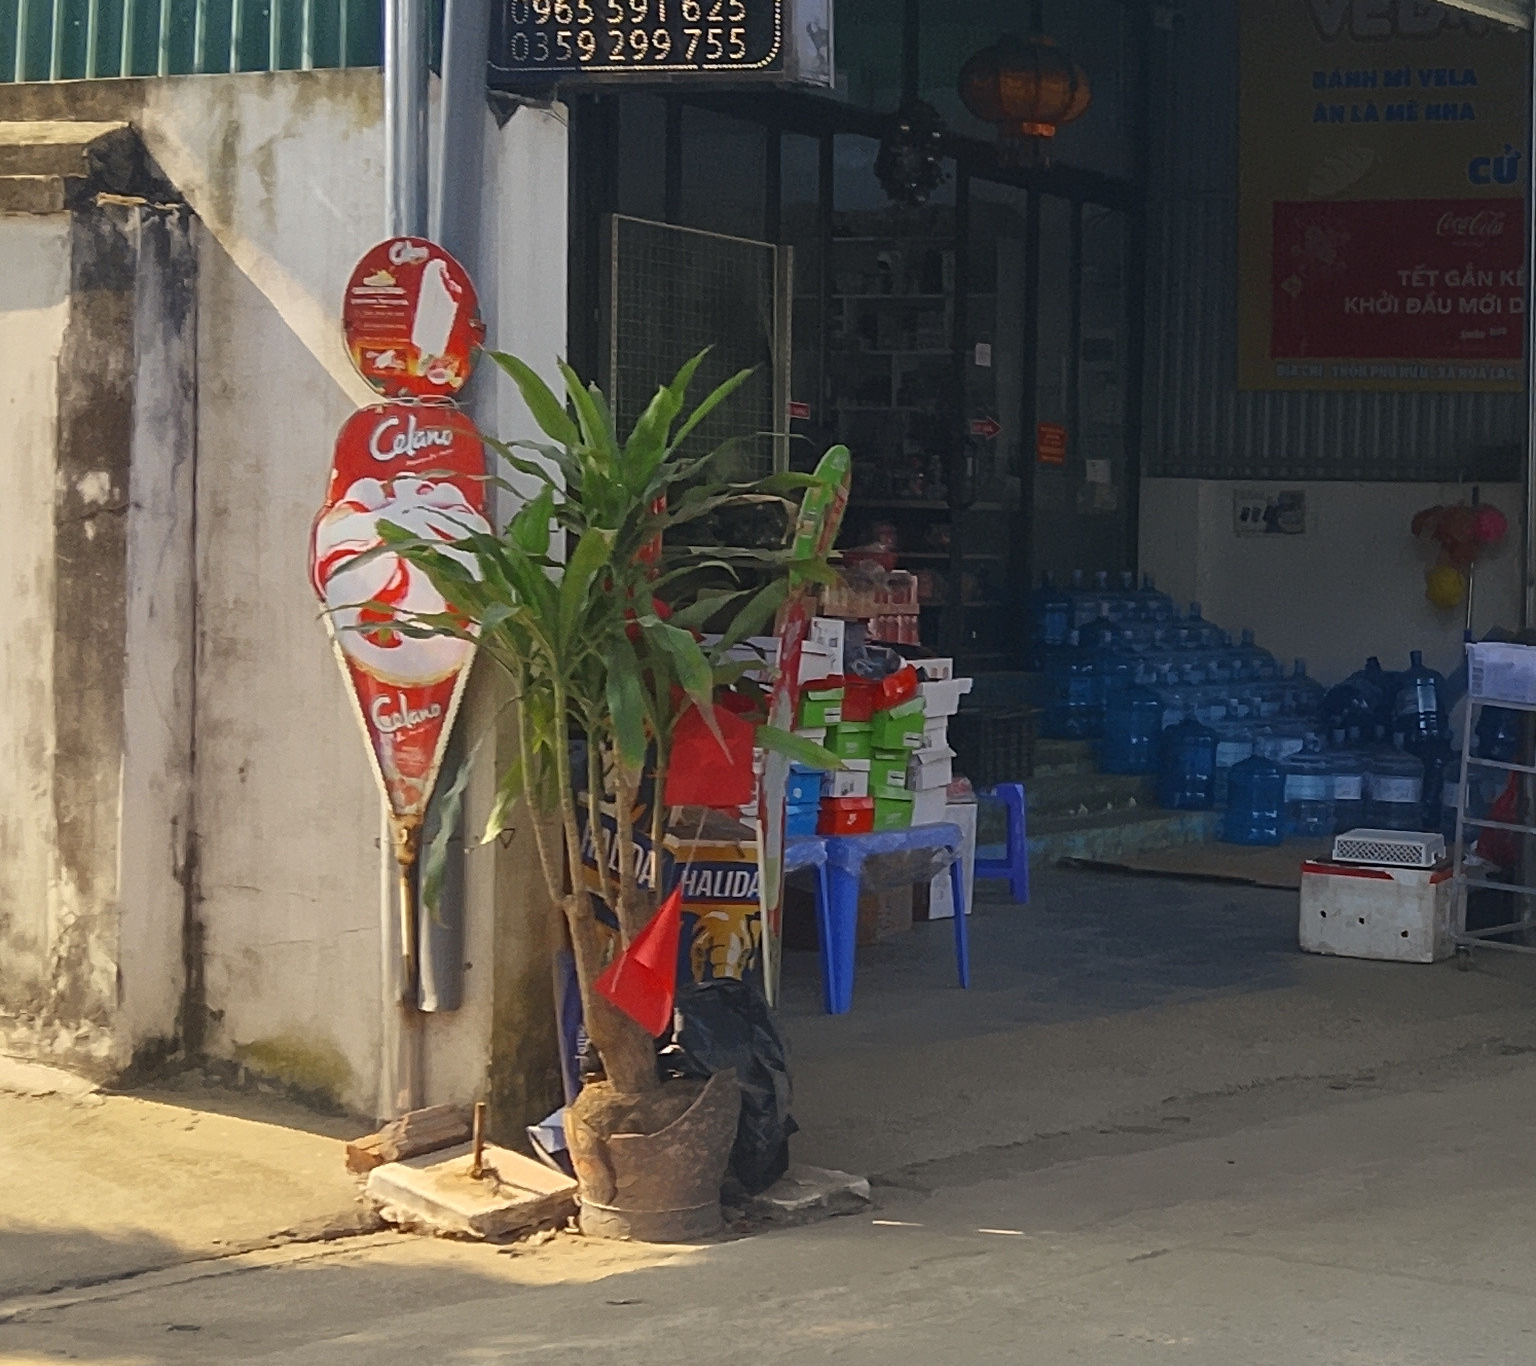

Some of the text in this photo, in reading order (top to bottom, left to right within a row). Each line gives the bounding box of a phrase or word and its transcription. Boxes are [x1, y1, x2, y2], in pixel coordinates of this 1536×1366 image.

[511, 27, 746, 63] 0359 299 755
[1417, 68, 1478, 87] VELA
[1468, 142, 1523, 185] CỬ
